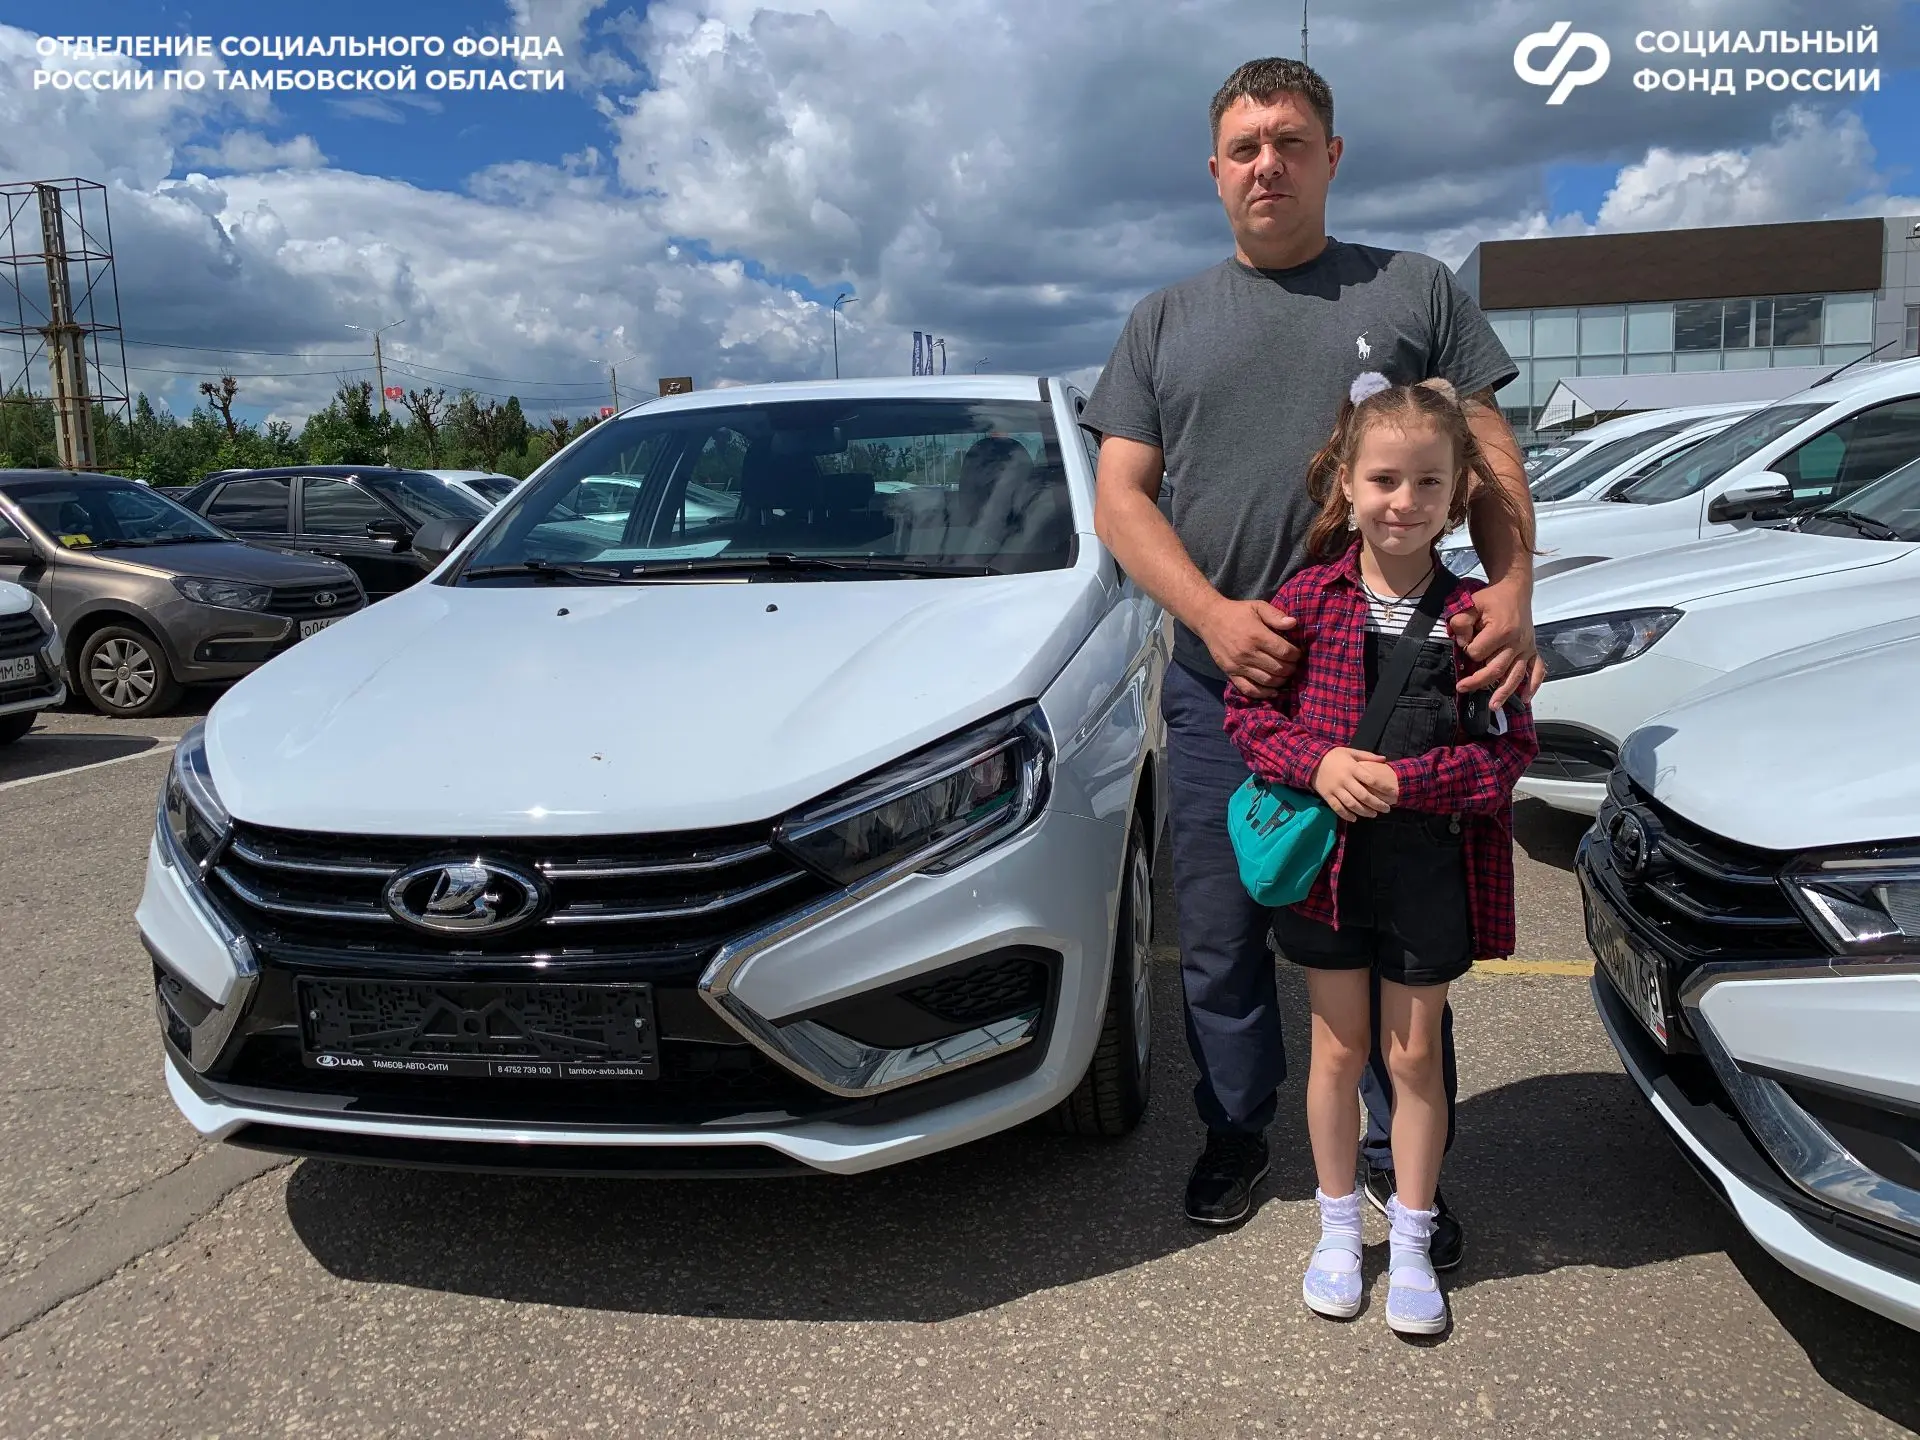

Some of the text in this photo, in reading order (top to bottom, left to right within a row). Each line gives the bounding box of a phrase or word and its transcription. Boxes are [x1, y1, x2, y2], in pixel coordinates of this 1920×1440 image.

[17, 658, 30, 672] 68
[340, 1059, 364, 1067] LADA
[373, 1060, 449, 1071] ТАМБОВ-АВТО-СИТИ
[497, 1065, 552, 1074] 8 4752 739 100
[568, 1067, 644, 1076] tambov-avto.lada.ru
